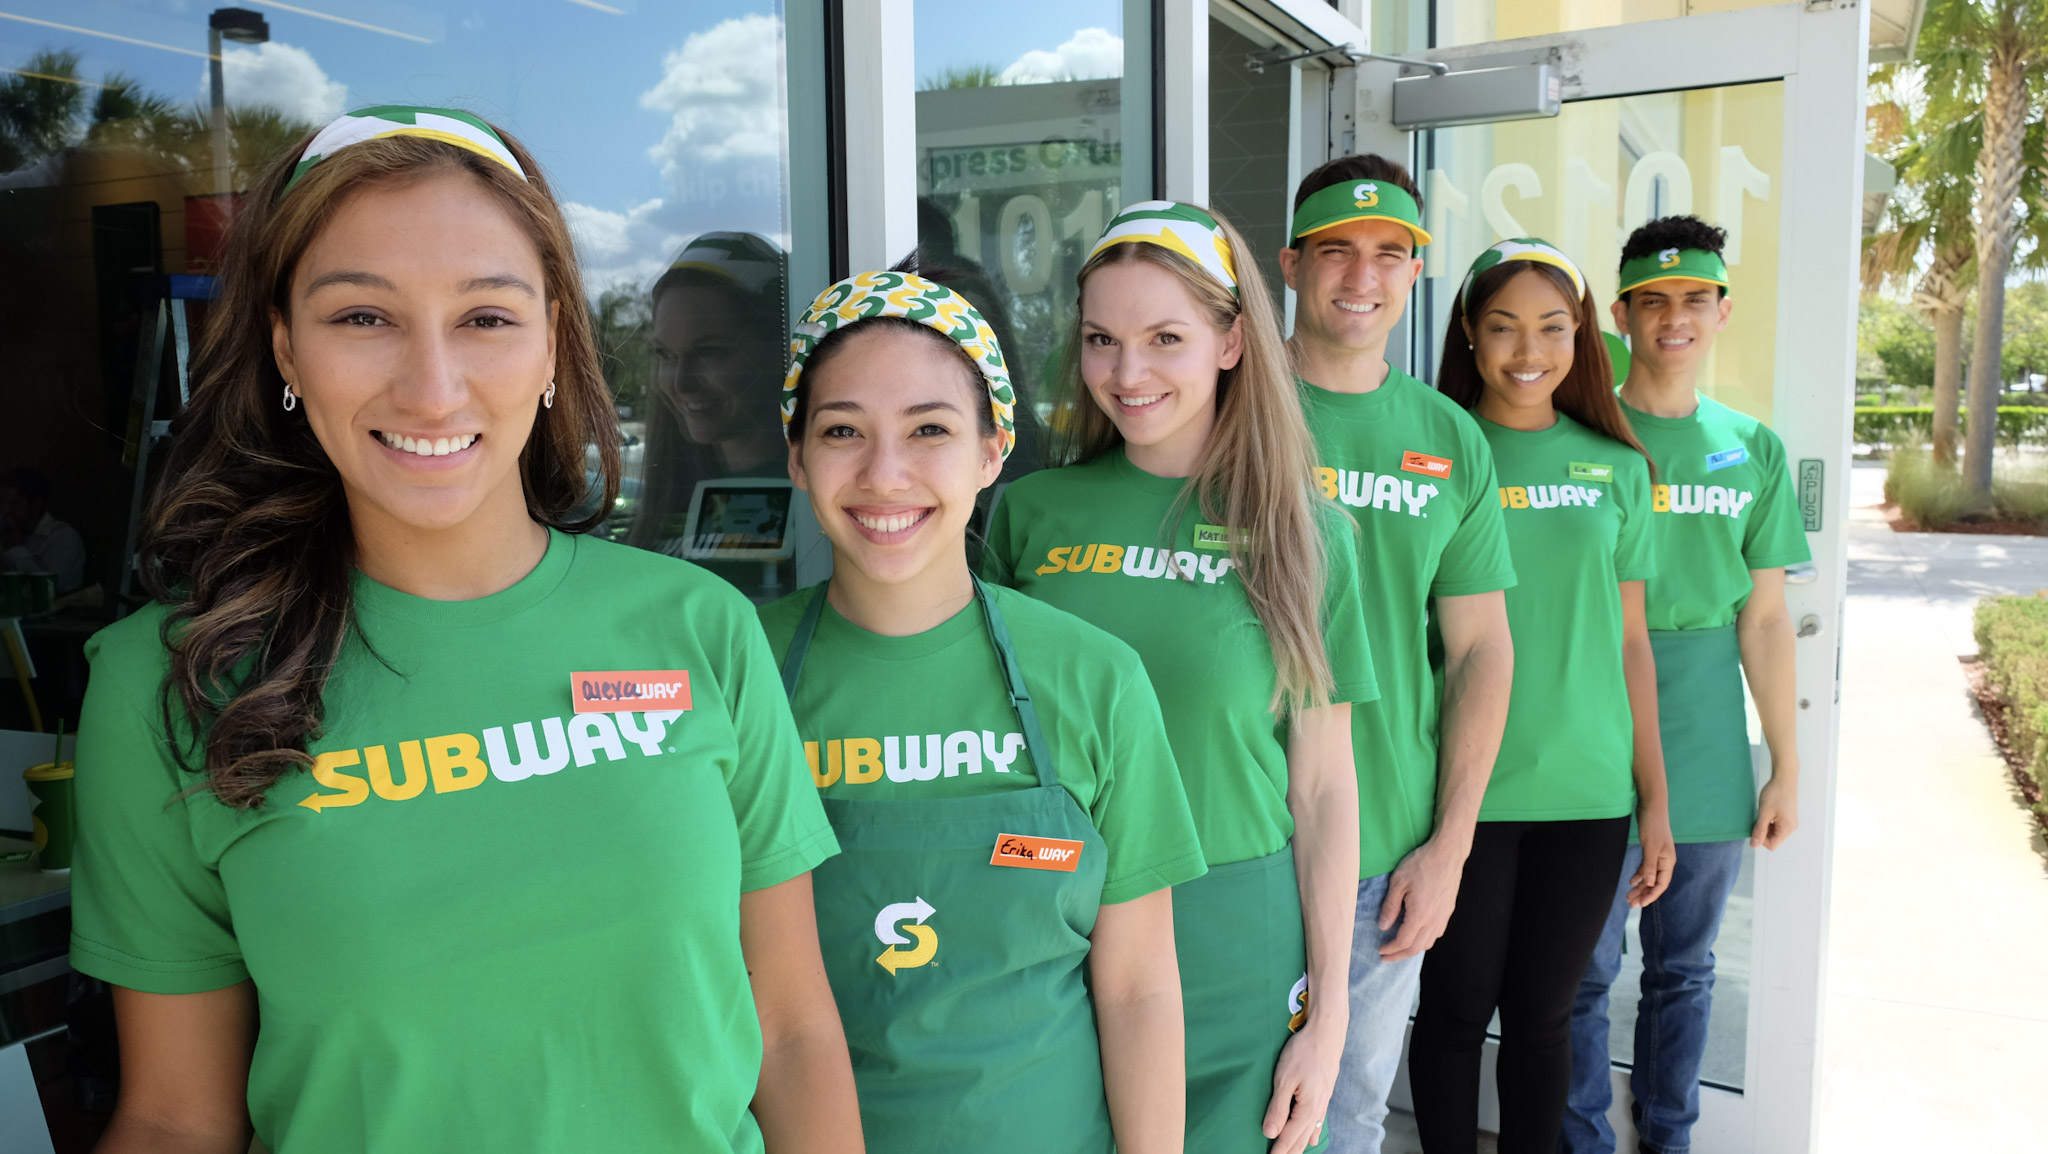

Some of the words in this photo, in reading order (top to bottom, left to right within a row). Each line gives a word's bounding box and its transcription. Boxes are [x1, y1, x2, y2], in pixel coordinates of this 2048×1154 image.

[1652, 484, 1753, 519] BWAY
[1804, 480, 1818, 529] PUSH
[1035, 543, 1243, 584] SUBWAY
[635, 682, 682, 699] WAY
[296, 711, 685, 814] SUBWAY
[803, 729, 1026, 788] UBWAY
[1000, 838, 1033, 861] Erika
[1038, 847, 1075, 862] WAY
